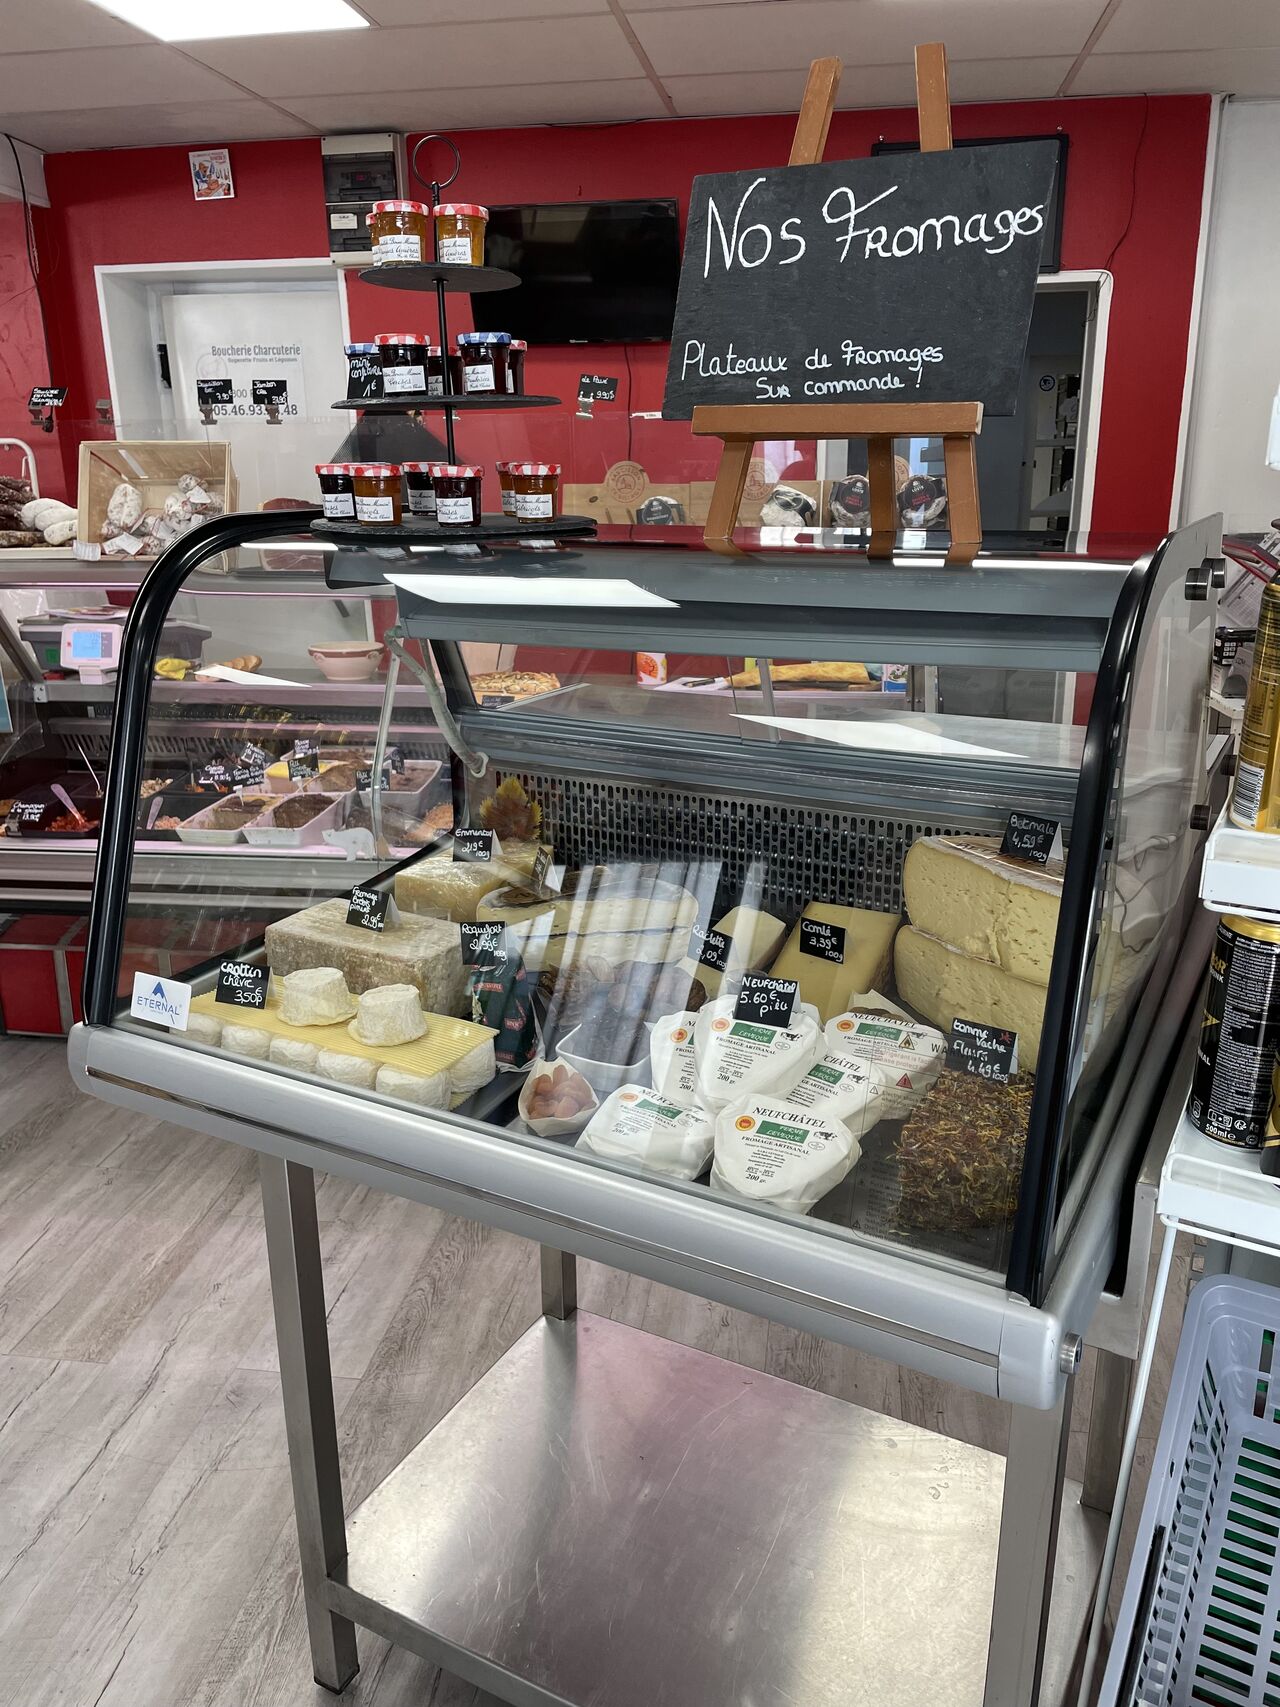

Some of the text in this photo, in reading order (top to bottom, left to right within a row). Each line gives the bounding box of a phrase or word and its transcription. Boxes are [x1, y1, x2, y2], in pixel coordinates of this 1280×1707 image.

[704, 177, 1044, 279] Nos Fromages
[211, 344, 301, 356] Boucherie Charcuterie
[681, 340, 944, 381] Plateaux de Fromages
[804, 374, 905, 396] commande
[1028, 850, 1047, 862] 100g
[461, 923, 502, 939] Roquefort
[692, 924, 725, 949] Raclette
[802, 921, 831, 937] Comté
[825, 950, 843, 963] 100g
[137, 995, 180, 1016] ETERNAL
[976, 1038, 1007, 1053] Vache
[717, 1073, 730, 1081] 200
[679, 1083, 692, 1091] 200
[752, 1106, 826, 1129] NEUFCHÂTEL
[780, 1125, 803, 1135] FERME
[741, 1136, 810, 1155] FROMAGE ARTISANAL
[745, 1173, 760, 1181] 200
